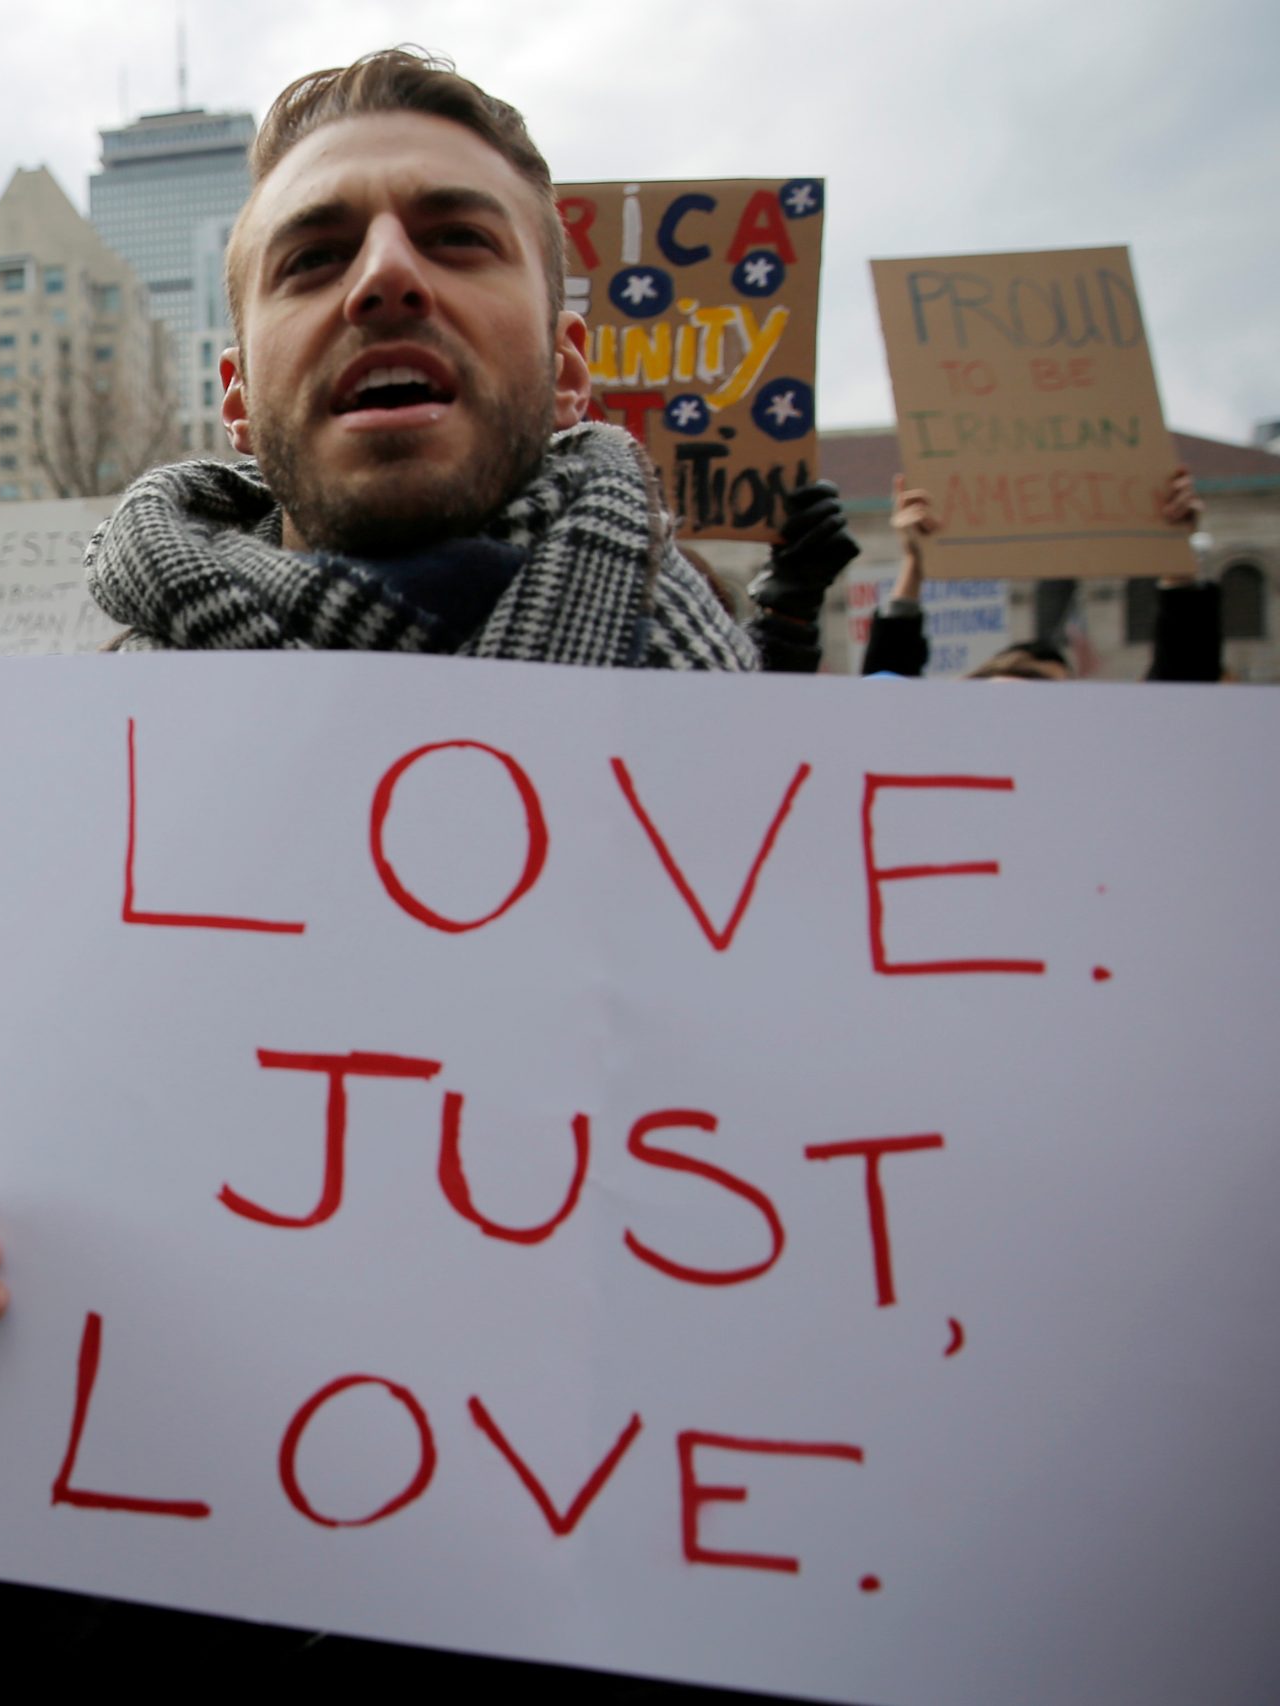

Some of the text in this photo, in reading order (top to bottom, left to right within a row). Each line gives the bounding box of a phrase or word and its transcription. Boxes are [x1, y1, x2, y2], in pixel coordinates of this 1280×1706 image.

[905, 267, 1146, 350] PROUD
[938, 357, 1095, 395] TO BE
[905, 409, 1142, 459] IRANIAN
[121, 718, 1111, 982] LOVE.
[217, 1047, 964, 1356] JUST,
[51, 1311, 880, 1591] LOVE.
